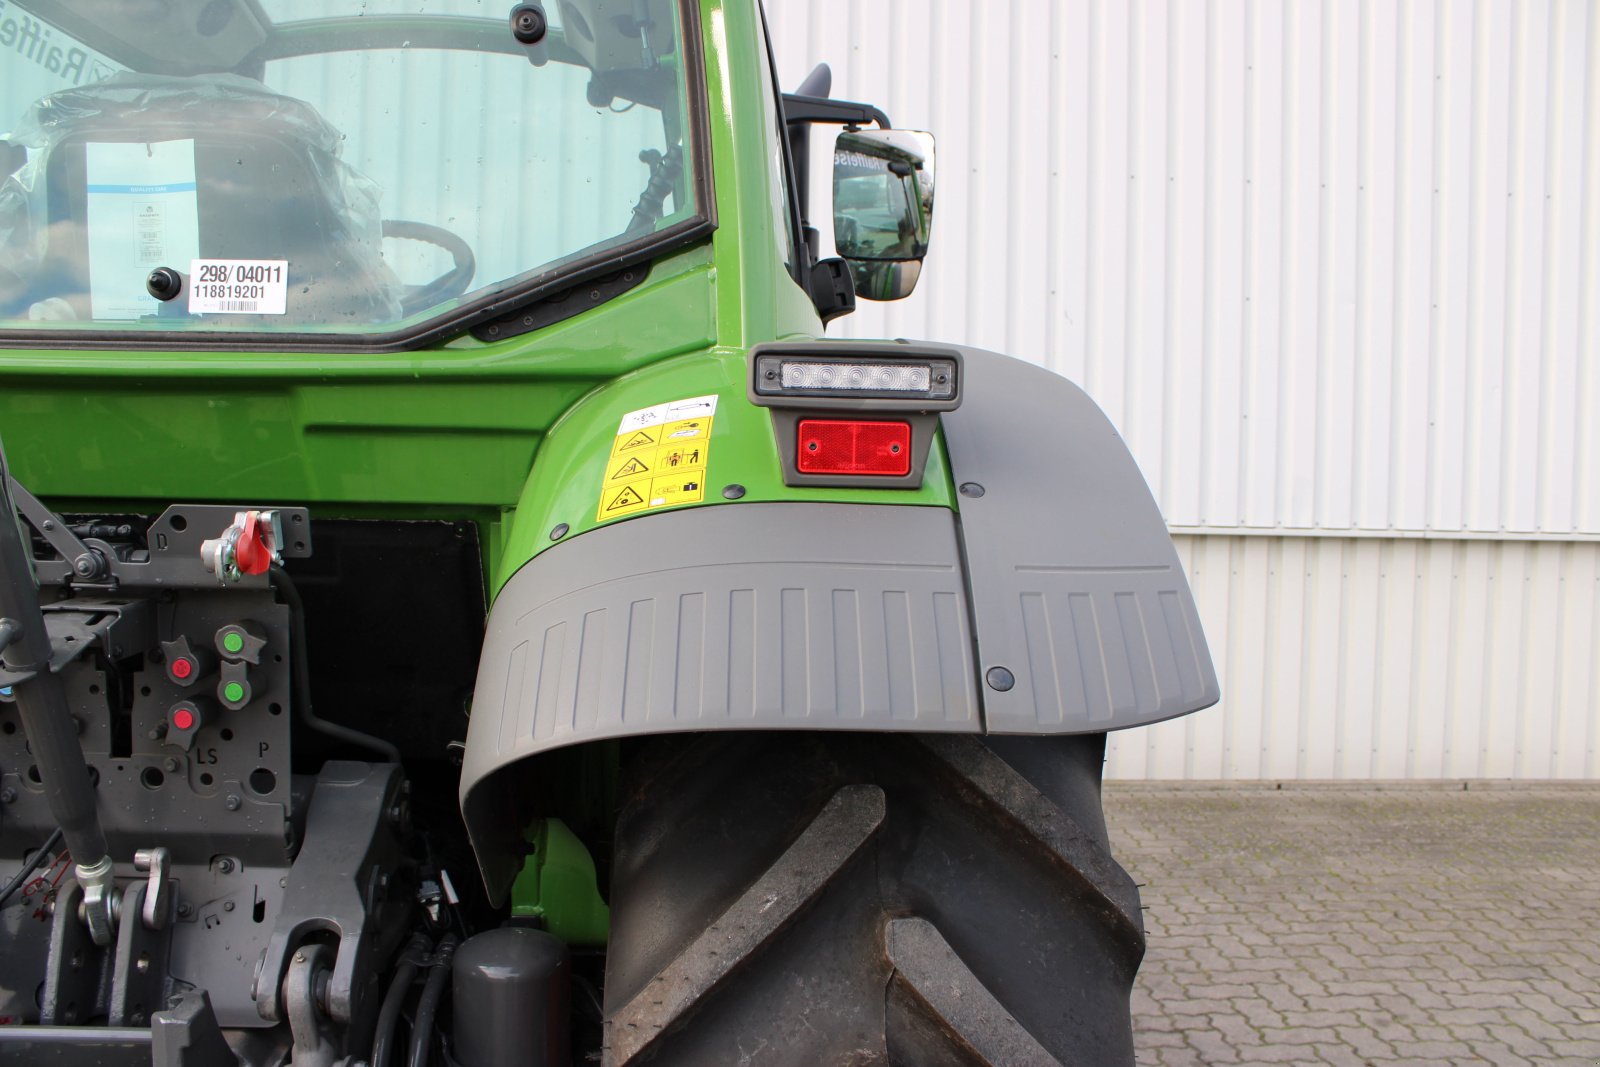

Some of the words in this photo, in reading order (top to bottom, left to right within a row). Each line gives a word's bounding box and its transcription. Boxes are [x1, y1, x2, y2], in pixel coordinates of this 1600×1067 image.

[194, 285, 264, 298] 118819201
[156, 533, 167, 549] D
[197, 748, 218, 765] LS
[259, 742, 269, 758] P
